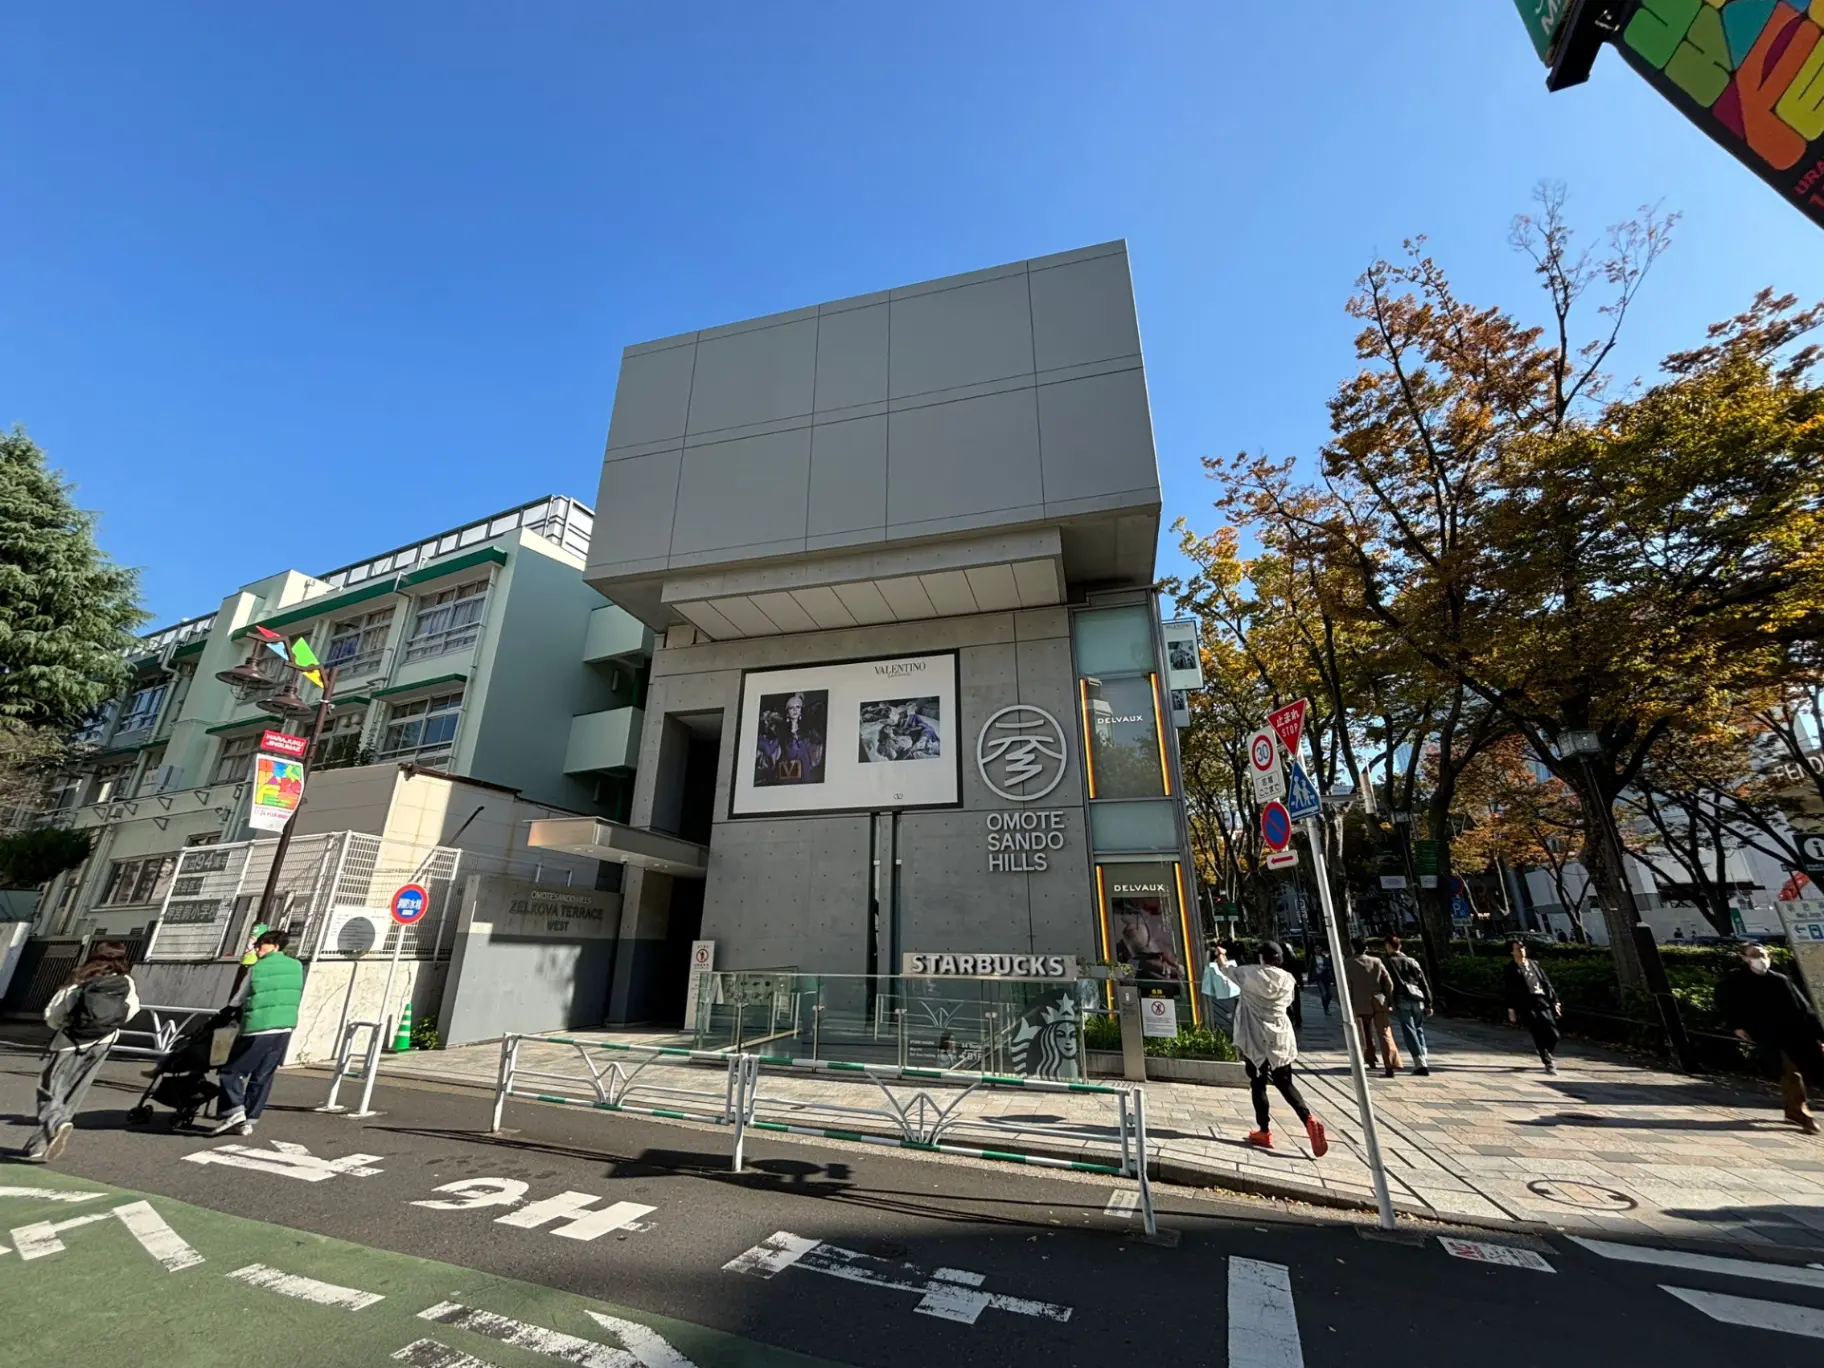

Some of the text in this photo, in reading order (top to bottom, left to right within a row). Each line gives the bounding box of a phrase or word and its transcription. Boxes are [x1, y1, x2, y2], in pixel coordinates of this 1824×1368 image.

[874, 661, 926, 675] VALENTINO
[1097, 715, 1143, 724] DELVAUX
[1276, 708, 1300, 728] 止まれ
[1281, 723, 1299, 738] STOP
[1256, 744, 1269, 762] 30
[1260, 783, 1279, 797] ここまで
[987, 811, 1065, 831] OMOTE
[987, 831, 1064, 851] SANDO
[988, 852, 1048, 872] HILLS
[1113, 884, 1165, 892] DELVAUX
[531, 890, 576, 903] OMOTESANDO
[509, 900, 604, 921] ZELKOVA TERRACE
[547, 920, 570, 932] WEST
[911, 953, 1064, 976] STARBUCKS
